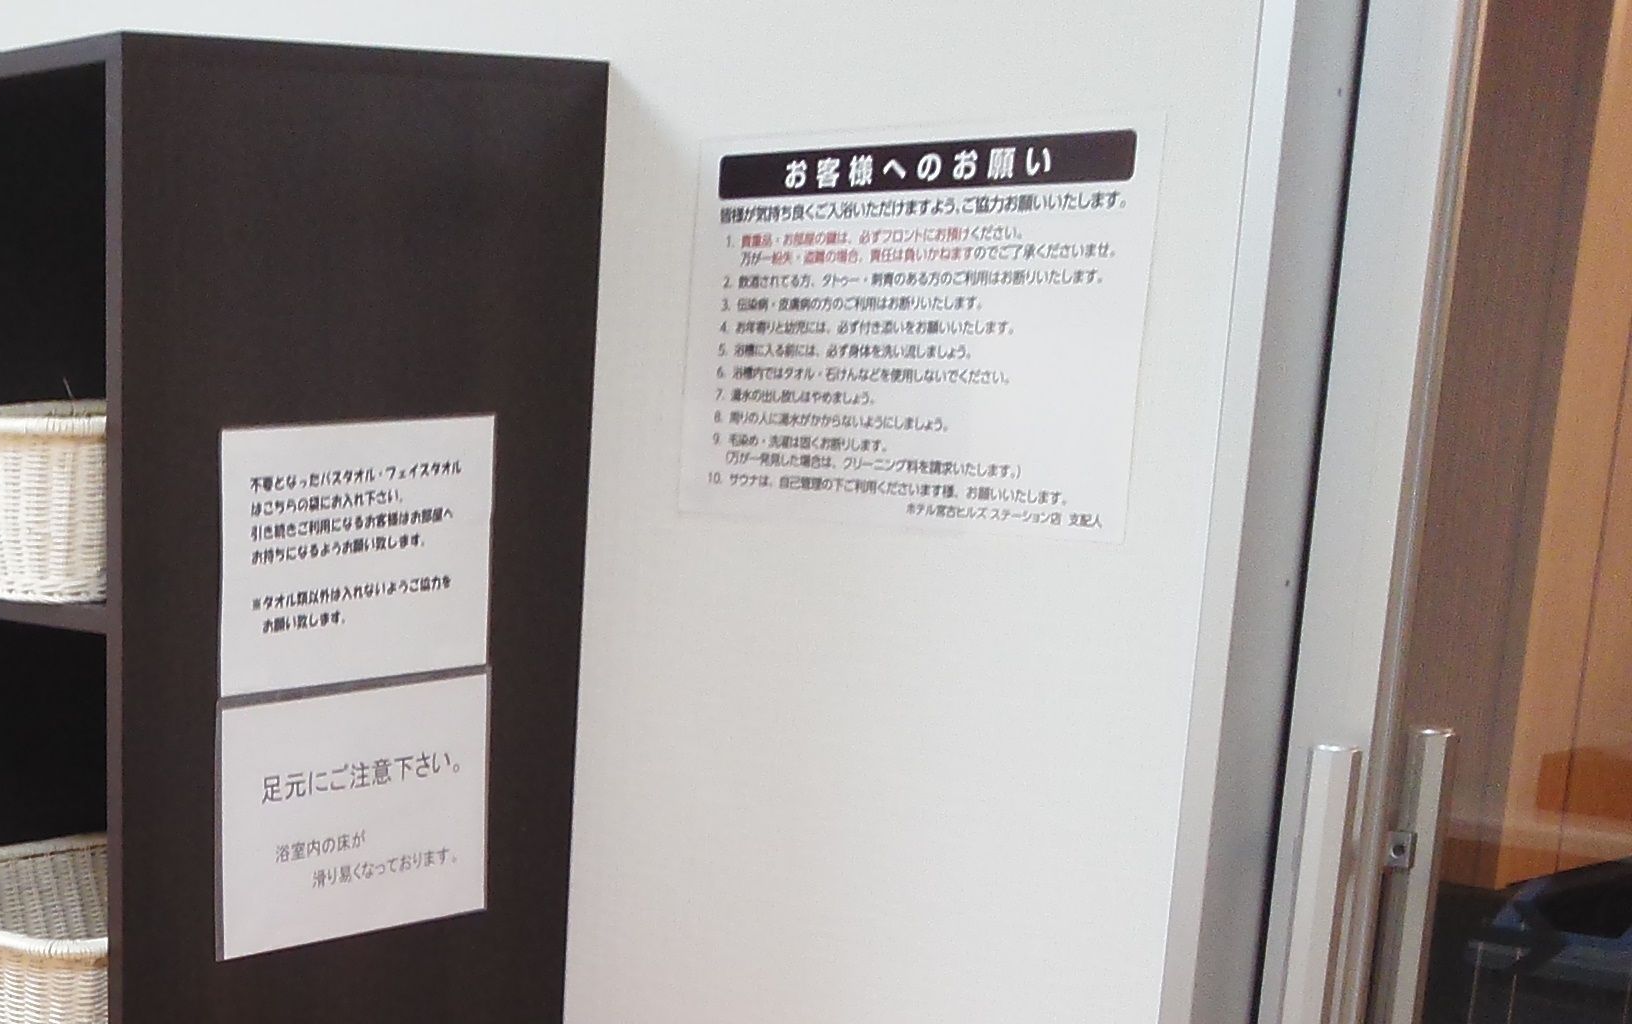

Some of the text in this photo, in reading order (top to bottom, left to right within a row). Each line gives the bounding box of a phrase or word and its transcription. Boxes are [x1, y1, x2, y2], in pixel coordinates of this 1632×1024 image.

[784, 146, 1053, 190] お客様へのお願い
[262, 610, 346, 634] お願い致します。
[262, 751, 460, 805] 足元にご注意下さい。
[275, 829, 366, 863] 浴室内の床が
[311, 848, 457, 888] 滑り易くなっております。
